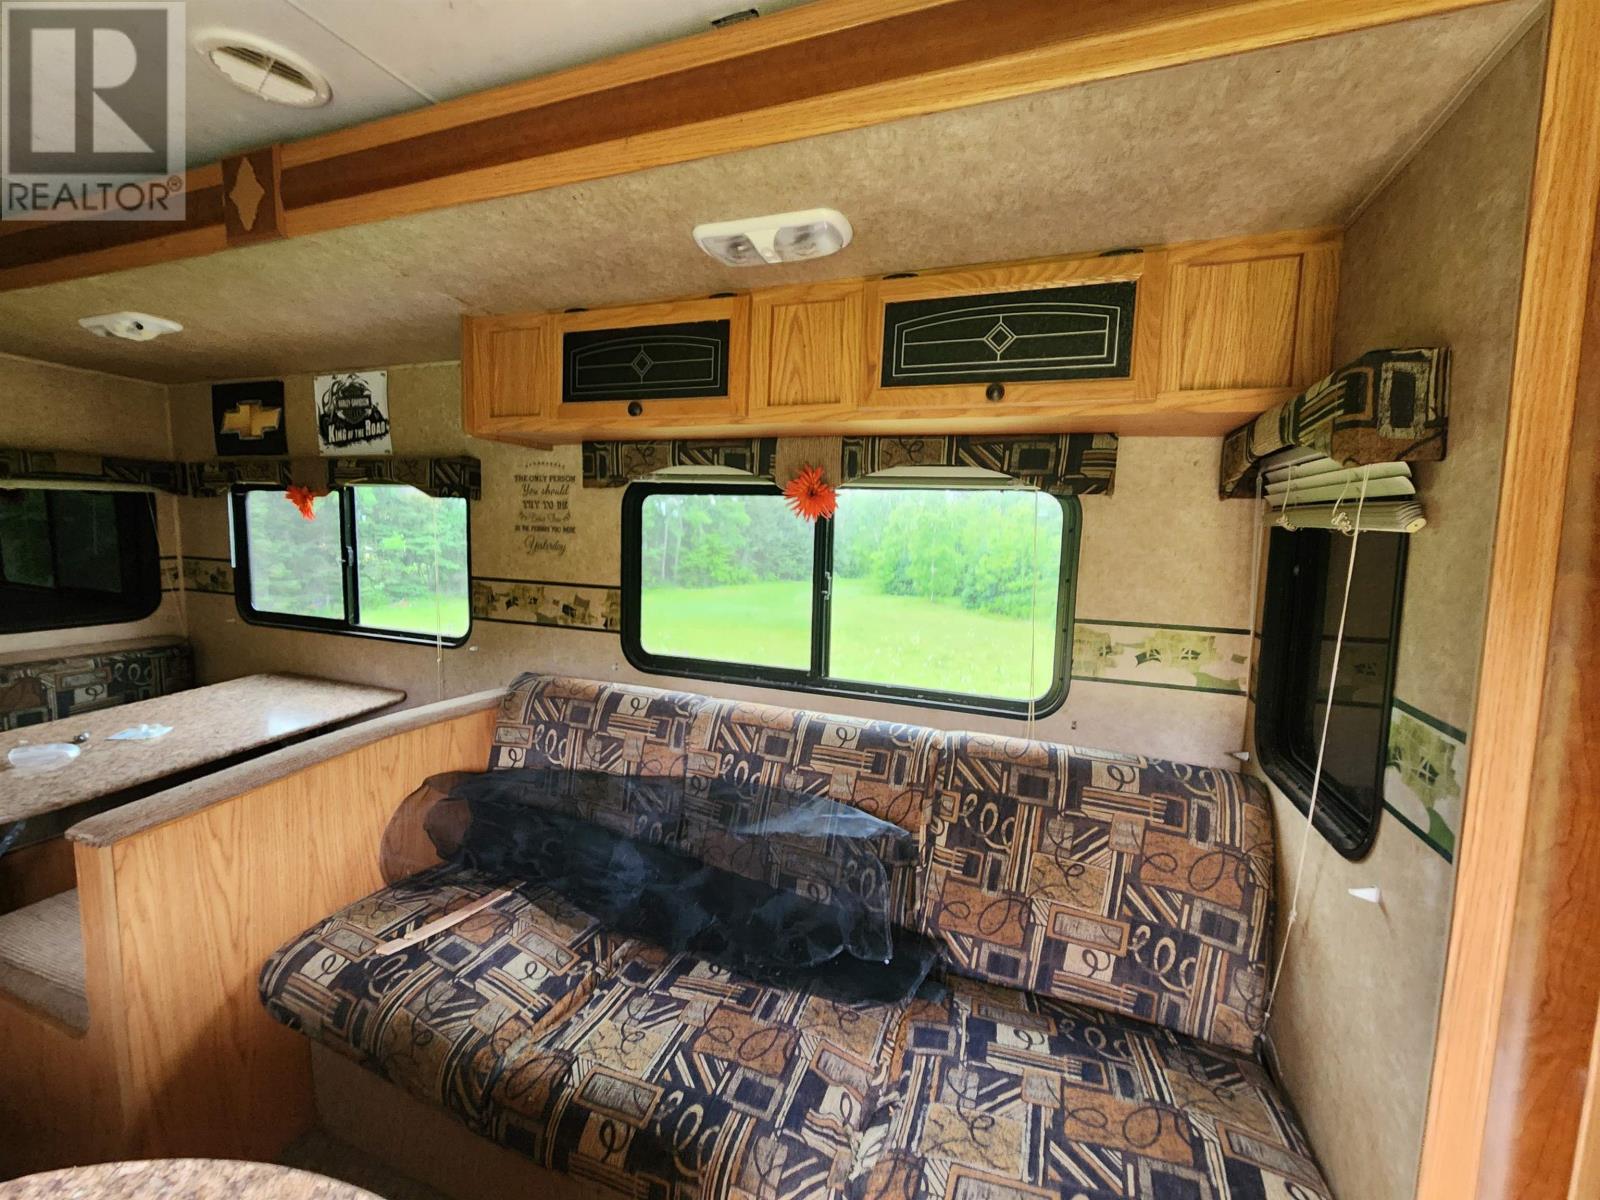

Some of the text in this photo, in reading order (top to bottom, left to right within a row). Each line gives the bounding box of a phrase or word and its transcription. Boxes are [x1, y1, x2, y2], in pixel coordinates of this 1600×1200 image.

[328, 424, 346, 442] KING
[365, 420, 385, 436] ROAD
[522, 483, 570, 496] You should
[543, 500, 554, 509] TO
[523, 534, 567, 556] Yesterday
